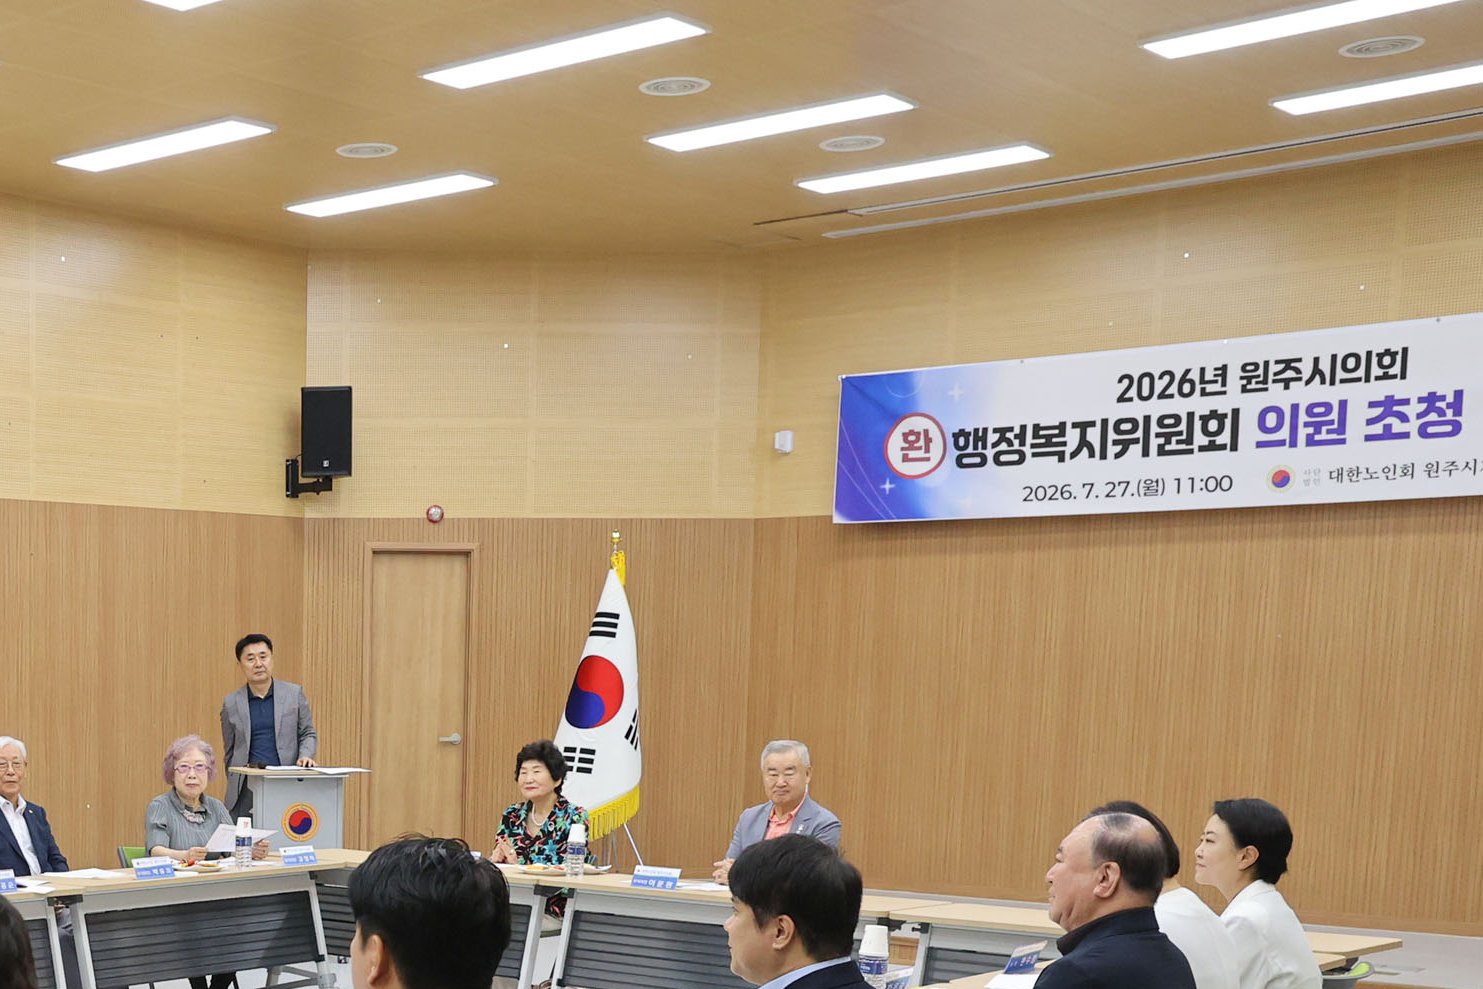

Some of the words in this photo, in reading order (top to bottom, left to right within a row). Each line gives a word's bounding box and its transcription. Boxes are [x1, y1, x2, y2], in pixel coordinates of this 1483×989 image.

[1116, 364, 1228, 404] 2026년
[1238, 346, 1409, 394] 원주시의회
[900, 427, 933, 464] 환
[952, 407, 1241, 469] 행정복지위원회
[1255, 399, 1348, 449] 의원
[1364, 389, 1464, 442] 초청
[1022, 483, 1078, 503] 2026.
[1082, 482, 1099, 500] 7.
[1104, 476, 1166, 499] 27.(월)
[1173, 474, 1234, 494] 11:00
[1329, 462, 1415, 484] 대한노인회
[1423, 458, 1483, 479] 원주시
